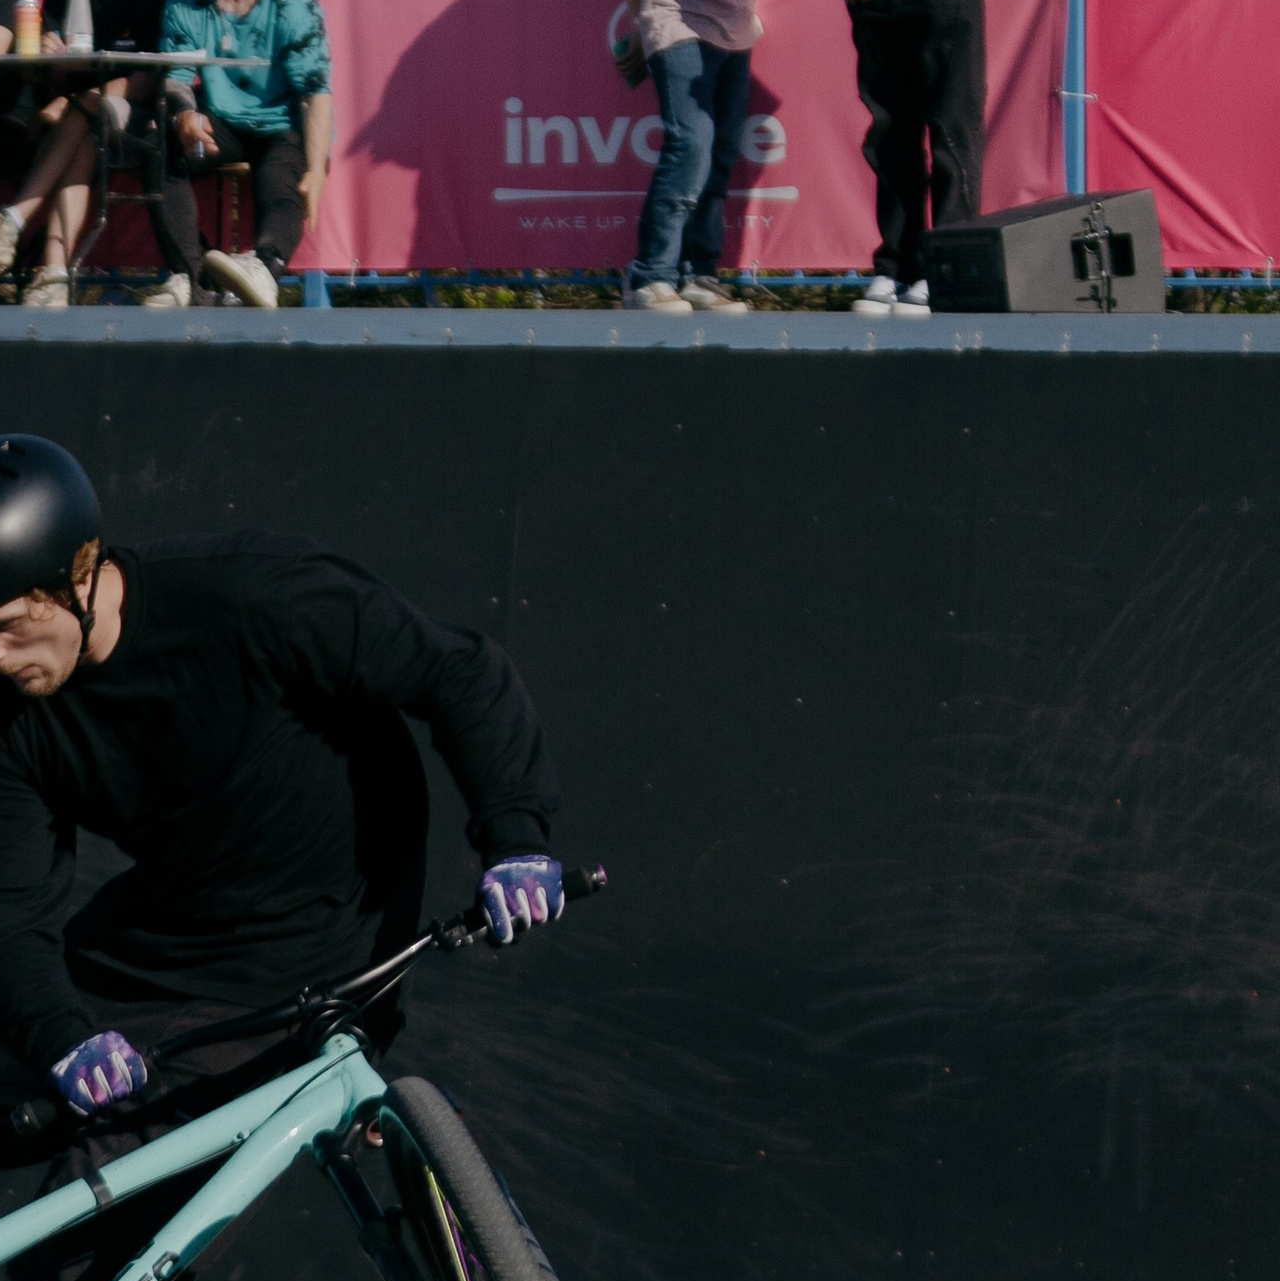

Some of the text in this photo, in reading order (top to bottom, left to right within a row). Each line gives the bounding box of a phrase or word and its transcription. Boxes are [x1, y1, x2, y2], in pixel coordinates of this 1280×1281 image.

[505, 97, 787, 164] invoe
[520, 215, 586, 229] WAKE
[596, 215, 627, 229] UP
